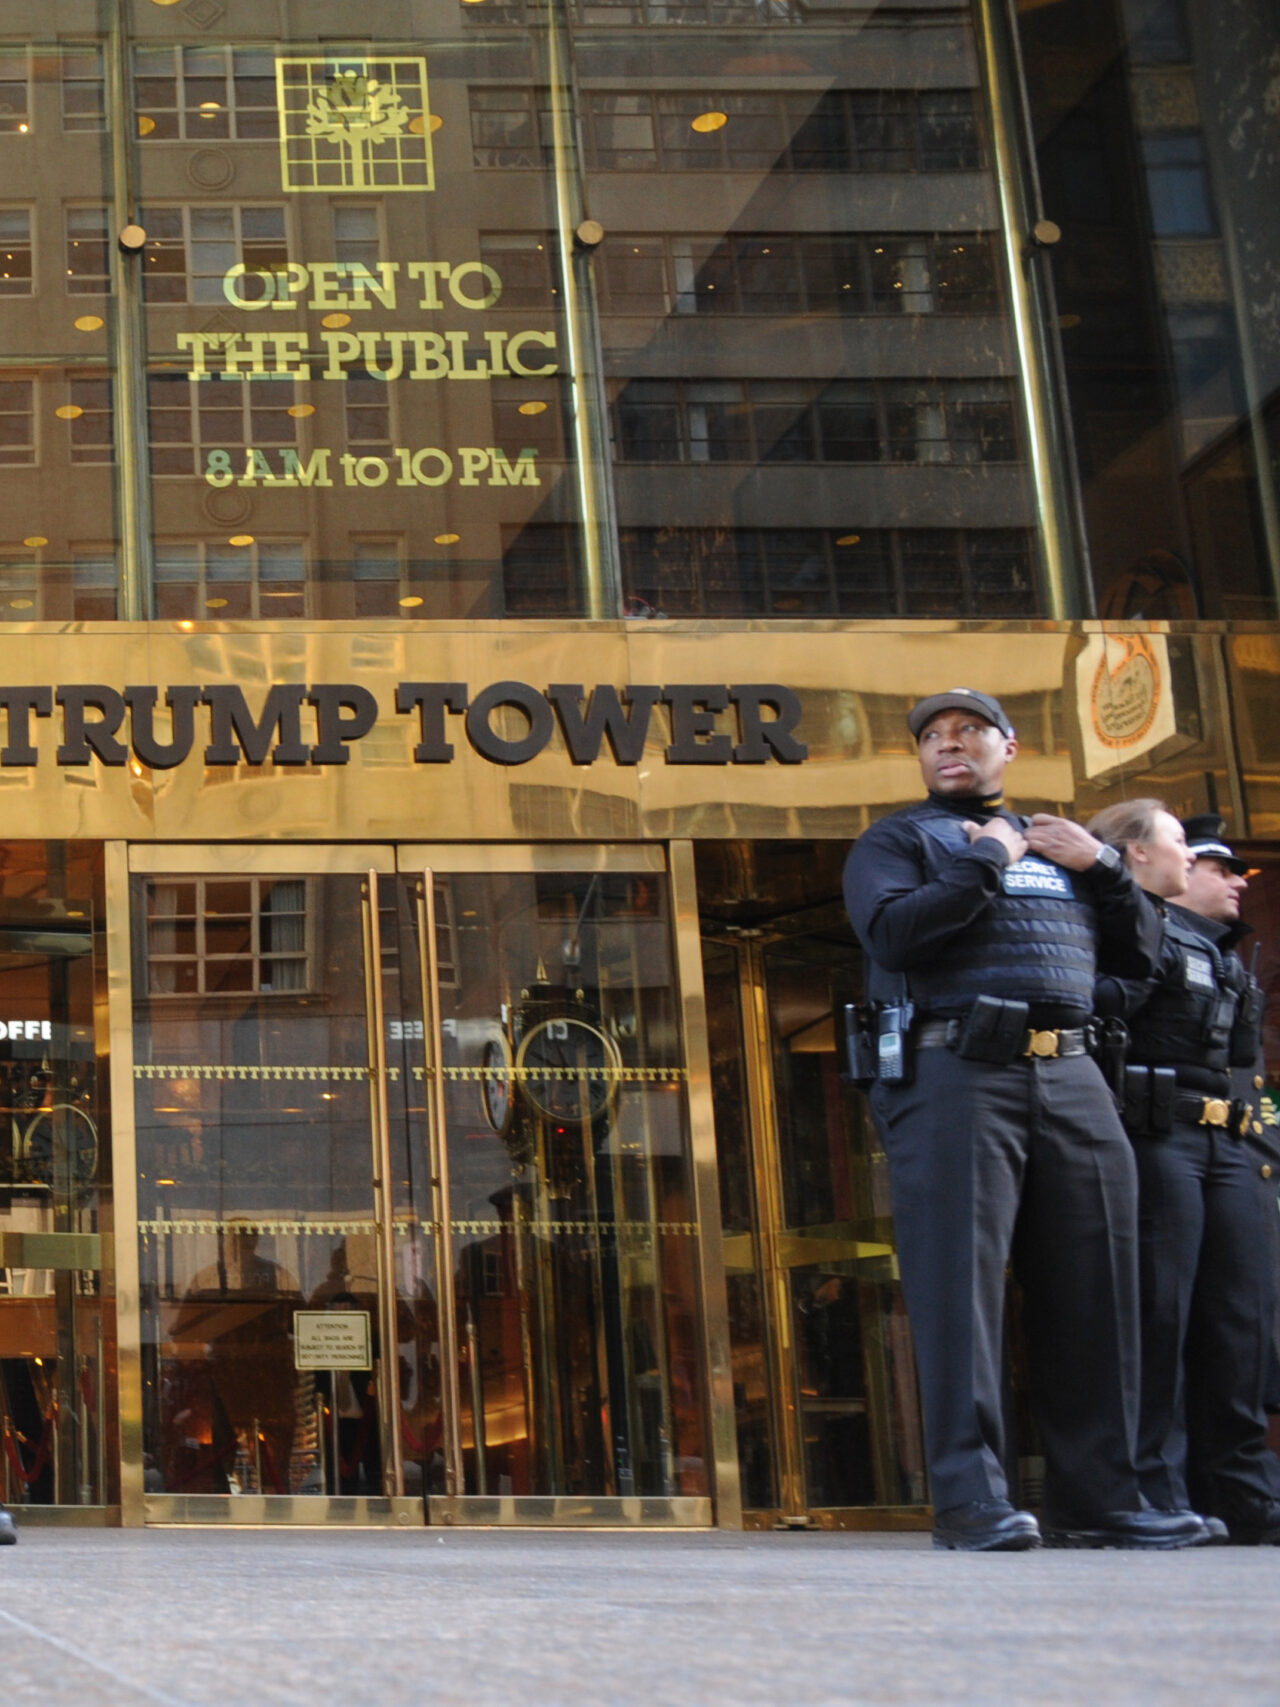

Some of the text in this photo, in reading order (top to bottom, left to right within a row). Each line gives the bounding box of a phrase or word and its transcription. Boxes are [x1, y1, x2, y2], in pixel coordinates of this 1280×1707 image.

[222, 261, 503, 311] OPEN TO
[176, 330, 558, 381] THE PUBLIC
[339, 453, 389, 487] to
[395, 447, 453, 487] 10
[458, 447, 541, 487] PM
[395, 681, 809, 766] TOWER
[1004, 874, 1067, 893] SERVICE
